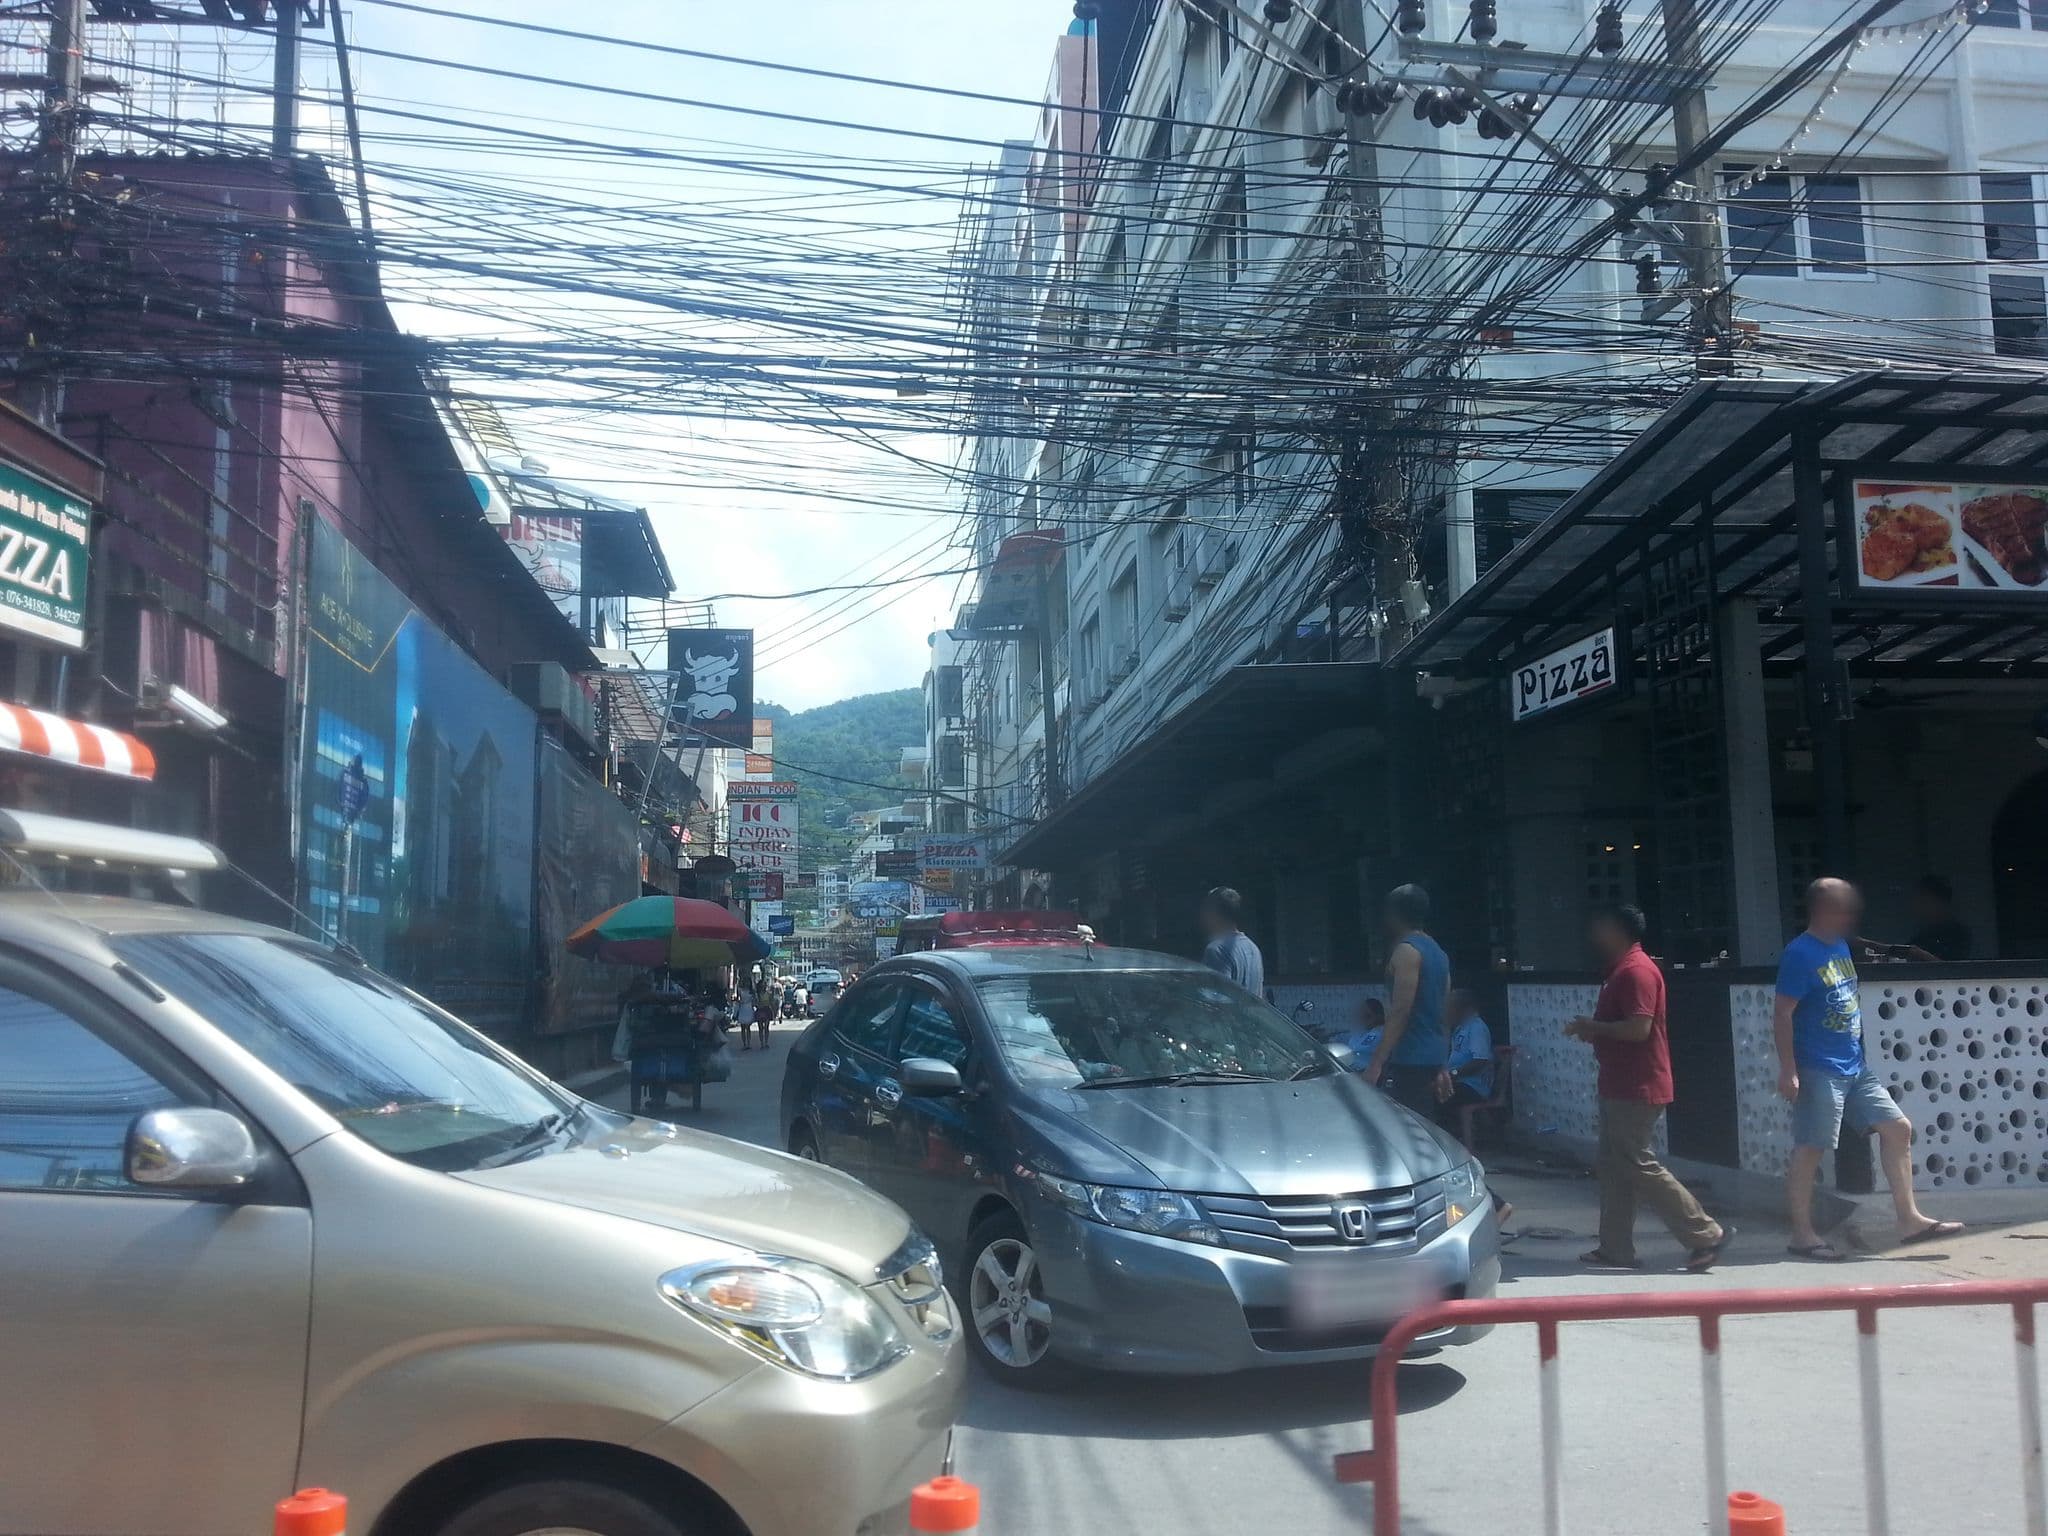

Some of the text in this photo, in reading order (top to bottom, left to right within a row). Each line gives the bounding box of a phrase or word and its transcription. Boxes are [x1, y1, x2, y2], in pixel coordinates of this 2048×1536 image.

[1518, 646, 1611, 713] Pizza
[768, 785, 796, 794] FOOD
[924, 845, 979, 857] PIZZA
[925, 857, 978, 866] Ristorante
